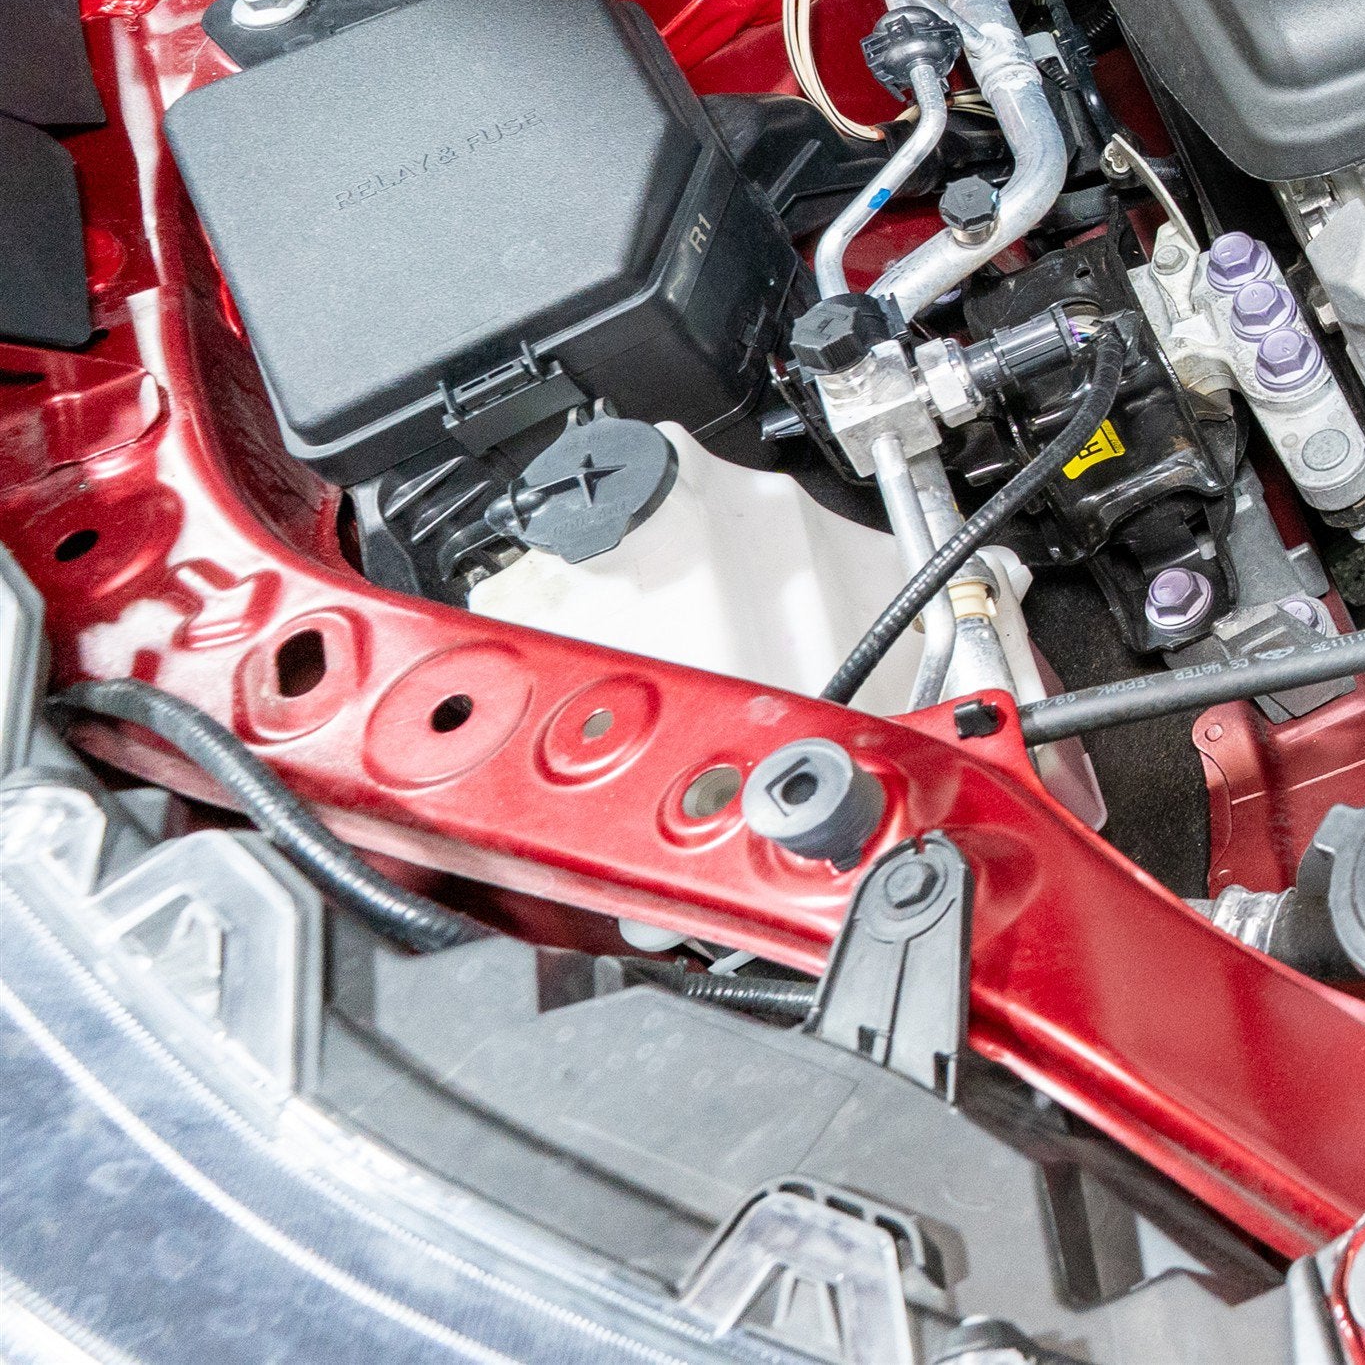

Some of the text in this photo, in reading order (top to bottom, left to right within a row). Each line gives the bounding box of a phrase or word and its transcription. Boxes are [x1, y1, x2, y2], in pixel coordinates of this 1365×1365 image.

[335, 108, 544, 211] RELAY & FUSE
[690, 213, 711, 254] R1
